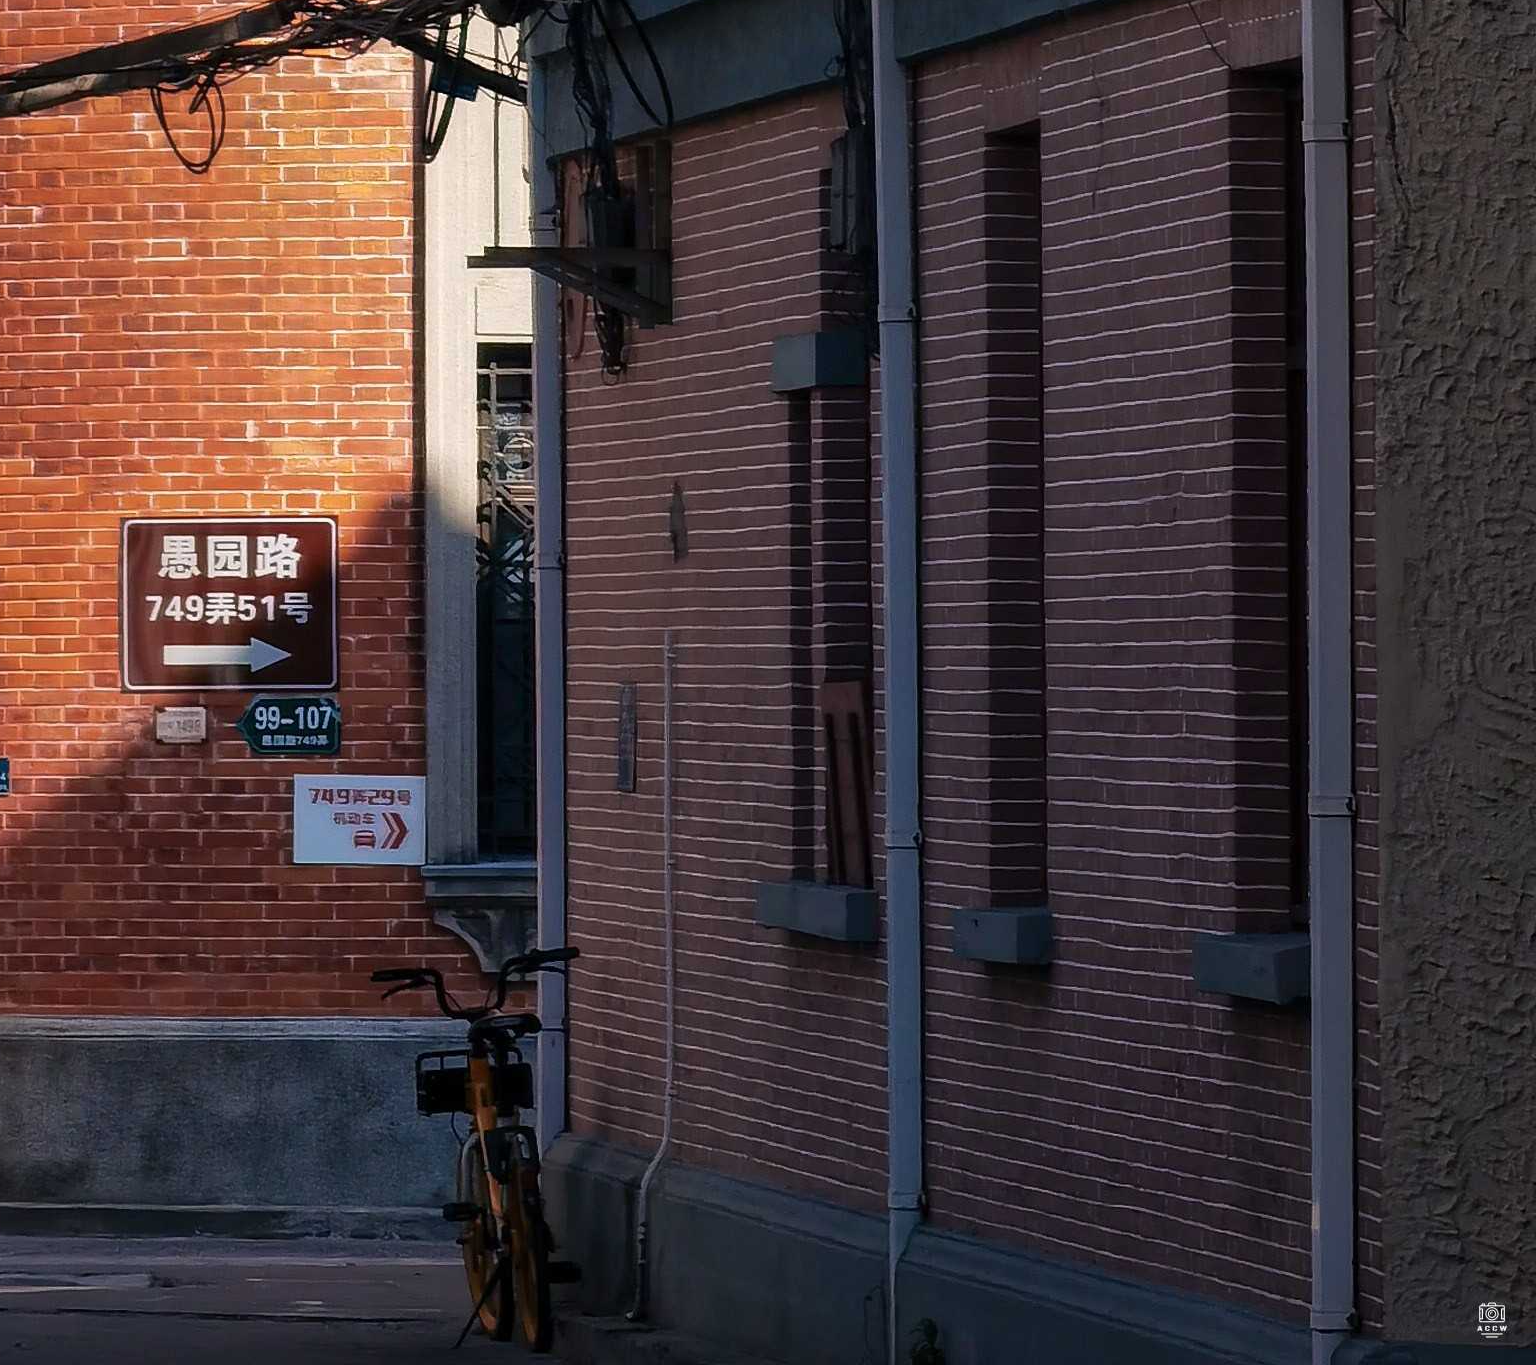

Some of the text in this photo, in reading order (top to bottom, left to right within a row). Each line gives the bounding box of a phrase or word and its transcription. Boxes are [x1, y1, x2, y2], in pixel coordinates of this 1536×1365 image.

[157, 533, 302, 580] 愚园路
[144, 591, 314, 625] 749弄51号
[254, 706, 333, 731] 99-107
[308, 788, 412, 806] 749弄29号
[333, 812, 377, 825] 机动车
